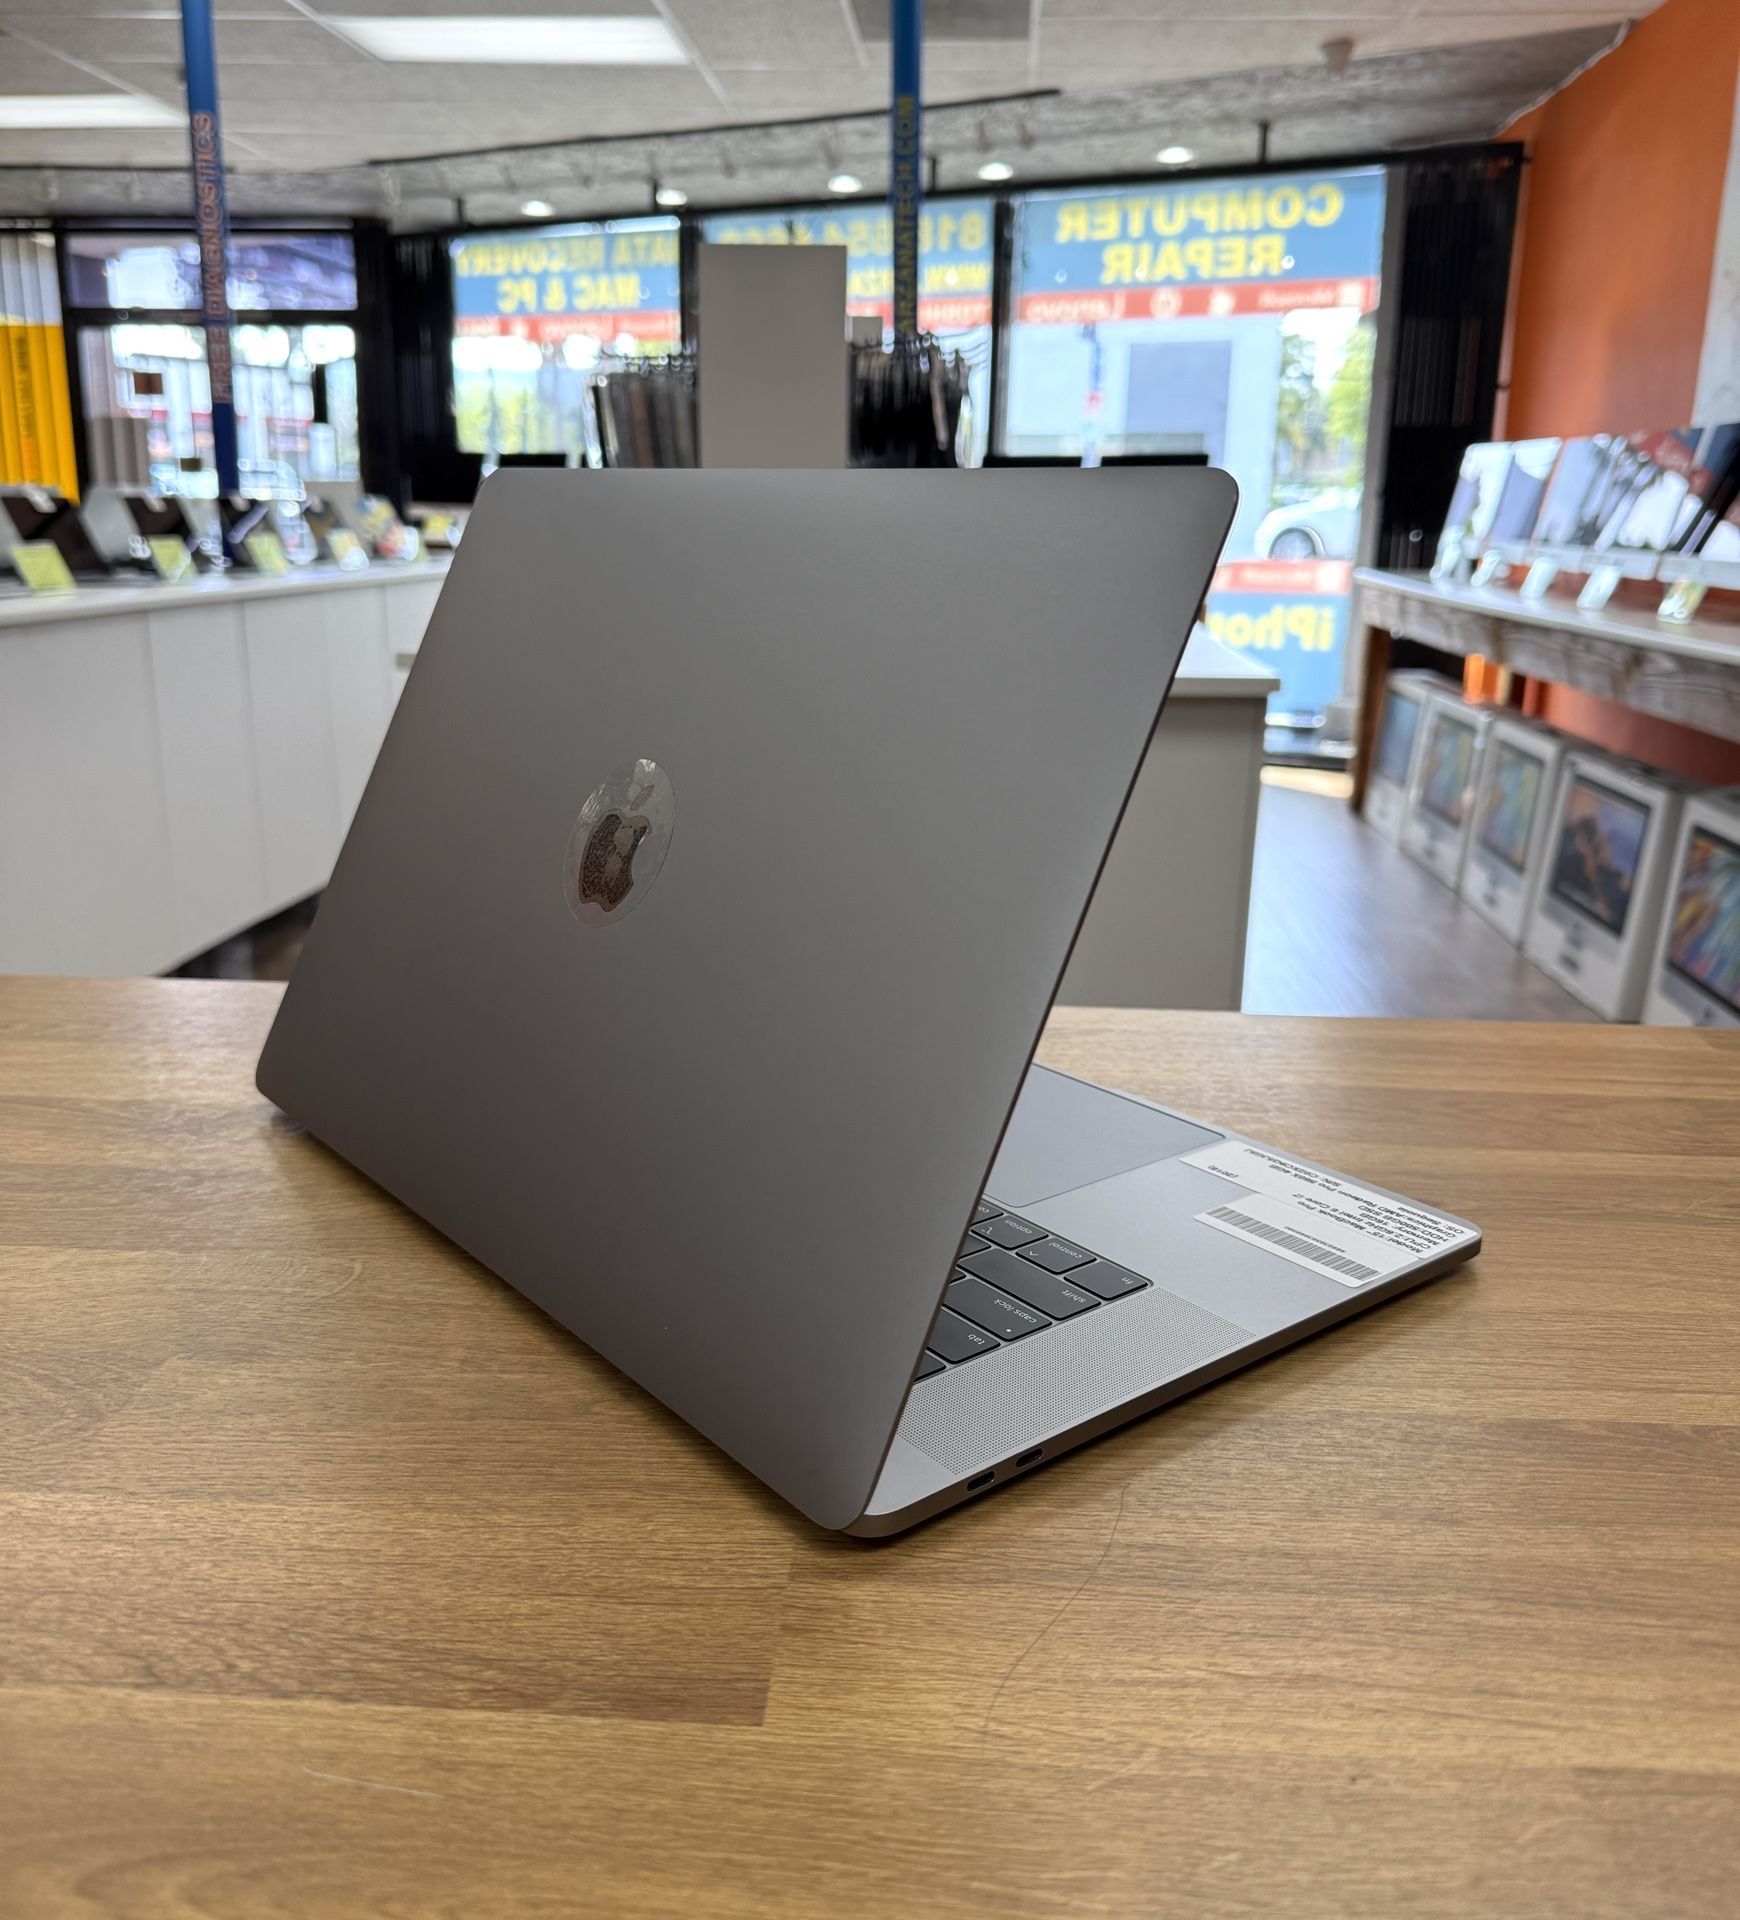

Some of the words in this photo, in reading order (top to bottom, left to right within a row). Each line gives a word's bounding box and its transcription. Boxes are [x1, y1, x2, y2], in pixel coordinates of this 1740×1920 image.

[190, 112, 226, 317] DIAGNOSTICS
[206, 325, 233, 403] FREE
[1295, 1201, 1316, 1209] Pro
[1303, 1197, 1330, 1208] Core
[1336, 1190, 1377, 1206] Radeon
[1338, 1211, 1363, 1221] Intel
[1356, 1205, 1382, 1215] SSD
[1395, 1206, 1442, 1224] Sequoia
[1004, 1218, 1033, 1235] option
[1315, 1209, 1366, 1230] MacBook
[1358, 1212, 1390, 1225] 16GB
[1390, 1225, 1440, 1245] Memory:
[1442, 1225, 1464, 1233] OS:
[1048, 1241, 1083, 1260] control
[1121, 1275, 1134, 1286] fn
[1061, 1288, 1087, 1304] shift
[992, 1297, 1014, 1314] lock
[1012, 1307, 1037, 1325] caps
[967, 1332, 985, 1346] tab
